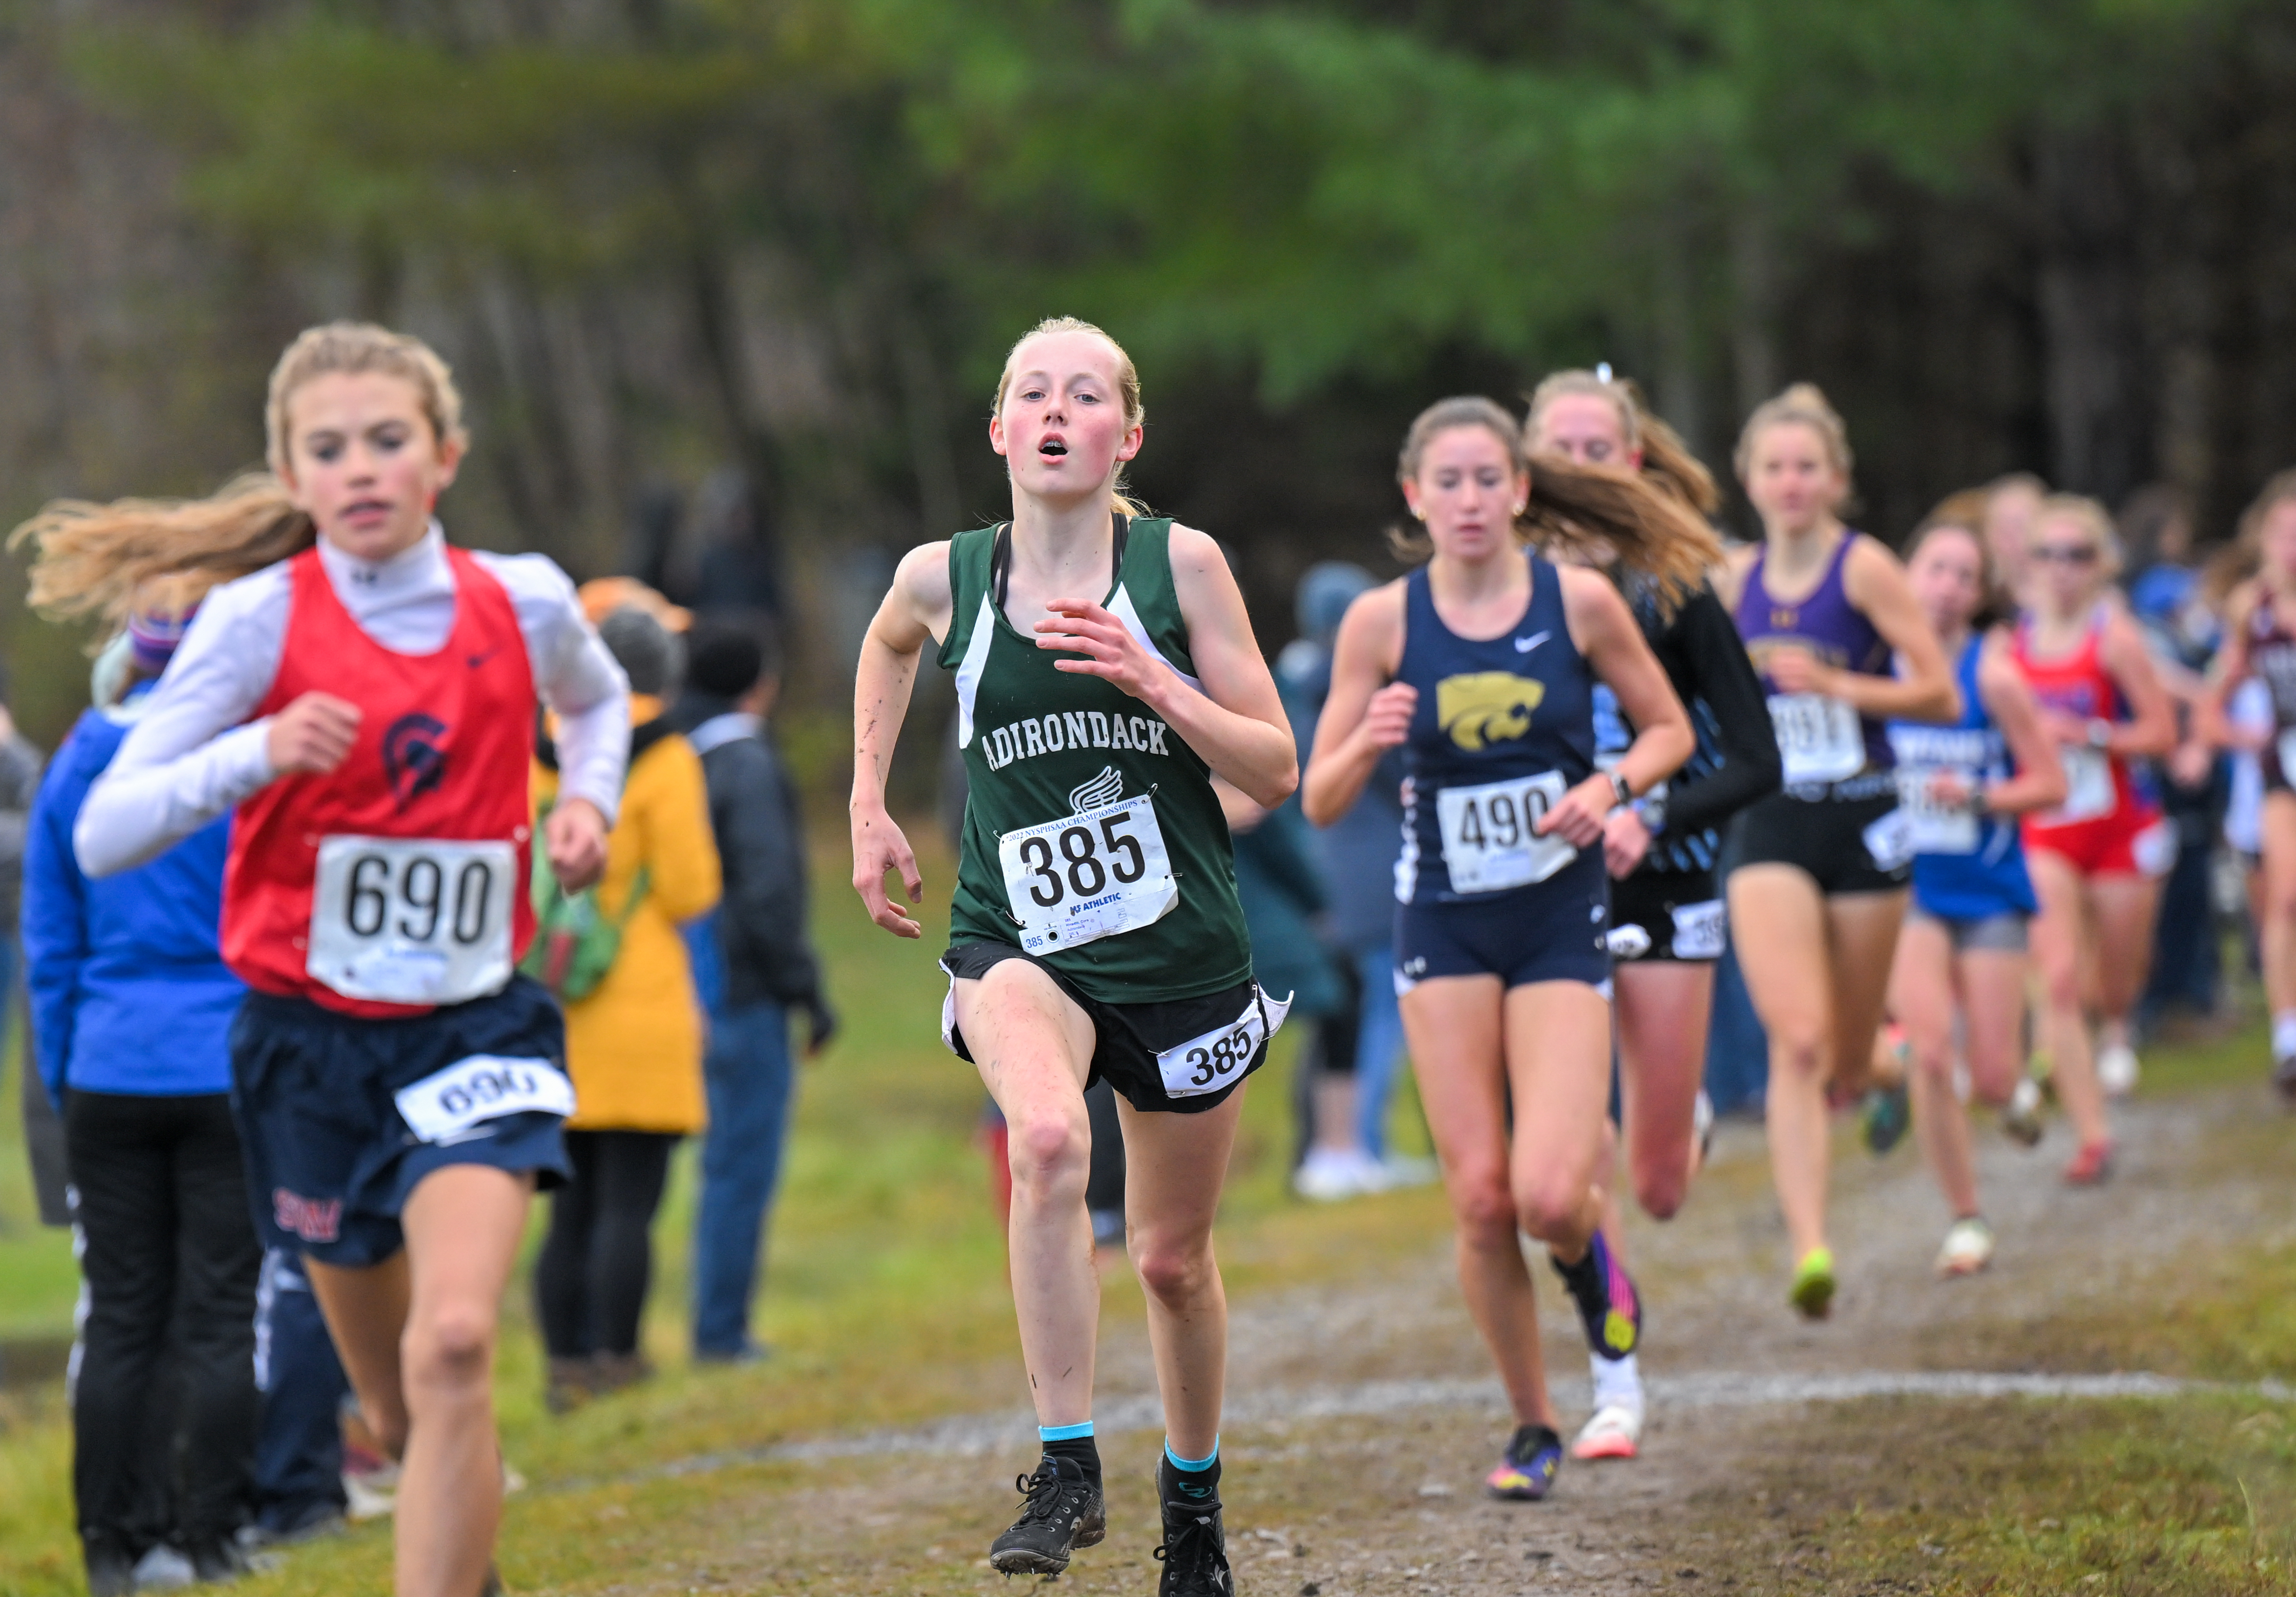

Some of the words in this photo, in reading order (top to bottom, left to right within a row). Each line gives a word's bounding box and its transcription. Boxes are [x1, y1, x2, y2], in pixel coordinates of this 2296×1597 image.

[982, 711, 1169, 772] ADIRONDACK
[1008, 832, 1024, 842] 2022
[1025, 821, 1067, 838] NYSPHSAA
[1067, 799, 1138, 827] CHAMPIONSHIPS
[1459, 786, 1549, 853] 490
[1020, 811, 1146, 907] 385
[345, 855, 493, 945] 690
[1083, 892, 1122, 911] ATHLETIC
[1026, 935, 1043, 949] 385
[1186, 1022, 1251, 1086] 385
